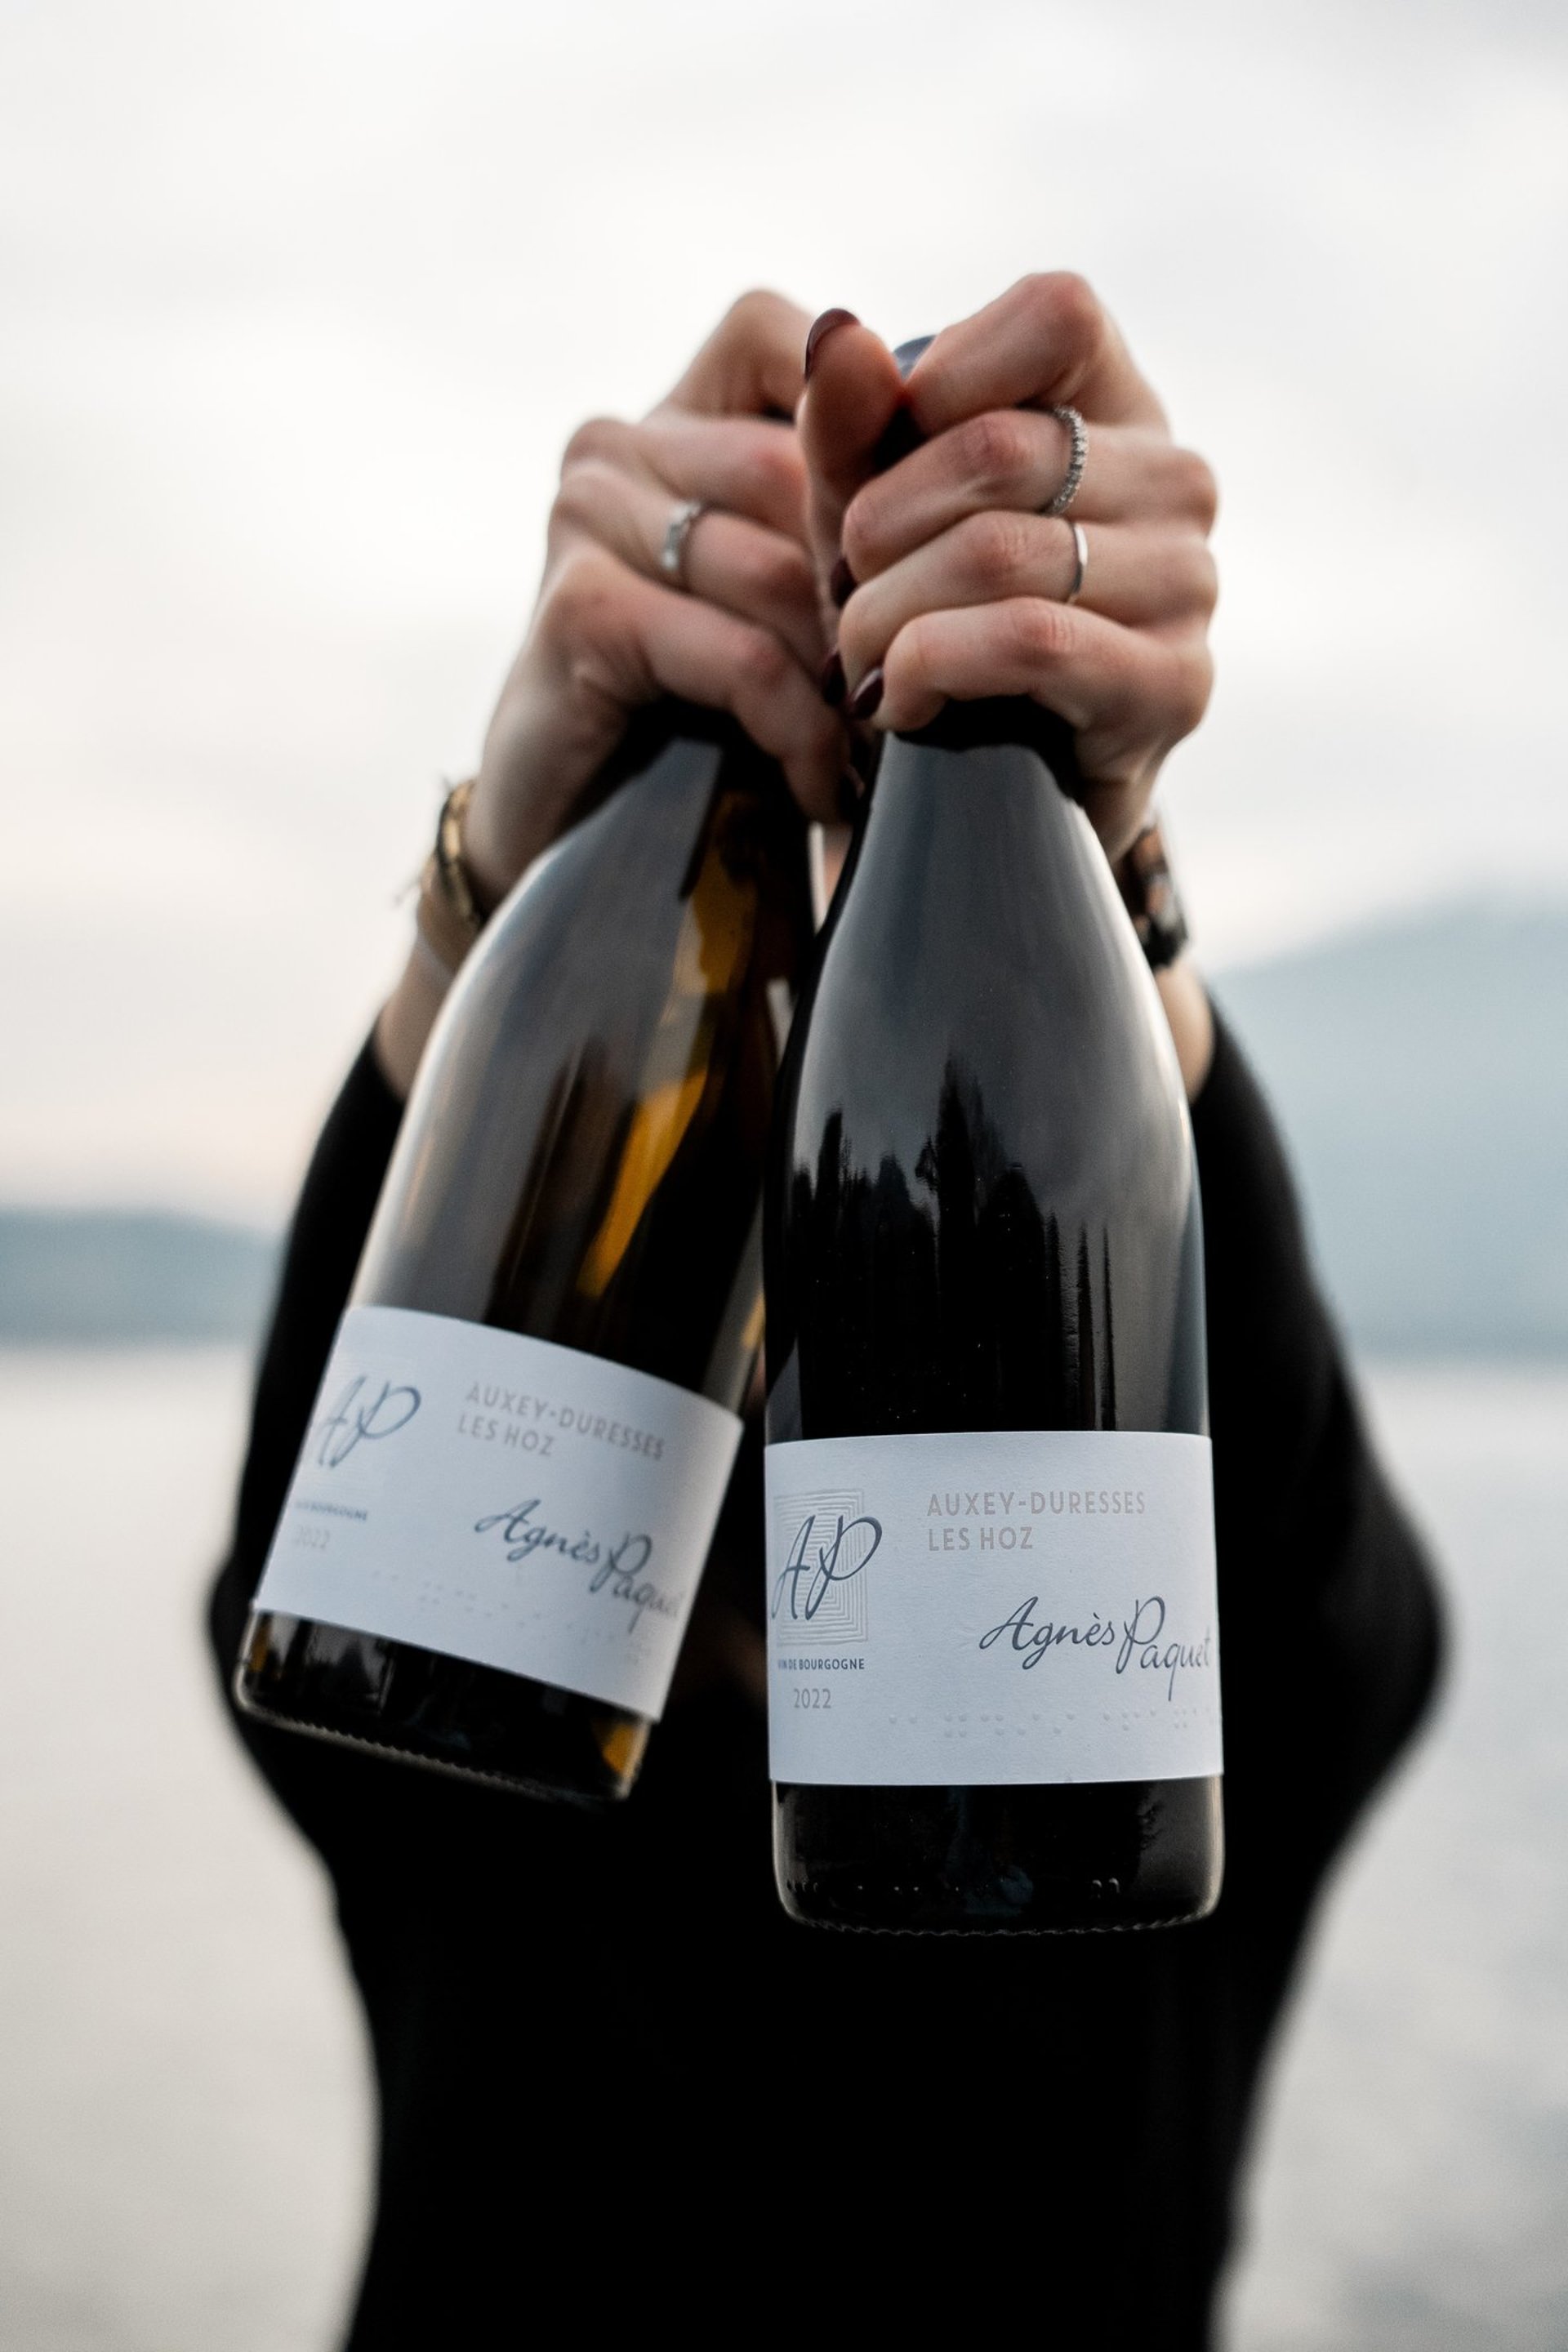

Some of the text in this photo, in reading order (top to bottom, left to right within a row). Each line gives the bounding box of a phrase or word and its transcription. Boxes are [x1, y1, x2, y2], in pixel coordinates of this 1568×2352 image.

[458, 1412, 555, 1458] LES HOZ
[465, 1380, 666, 1461] AUXEY-DURESSES
[927, 1490, 1146, 1517] AUXEY-DURESSES
[474, 1498, 601, 1564] Agnès
[929, 1526, 1033, 1552] LES HOZ
[771, 1514, 883, 1620] AP
[788, 1659, 798, 1670] DE
[799, 1658, 866, 1671] BOURGOGNE
[978, 1595, 1211, 1702] Agnès Paquet
[793, 1687, 832, 1710] 2022
